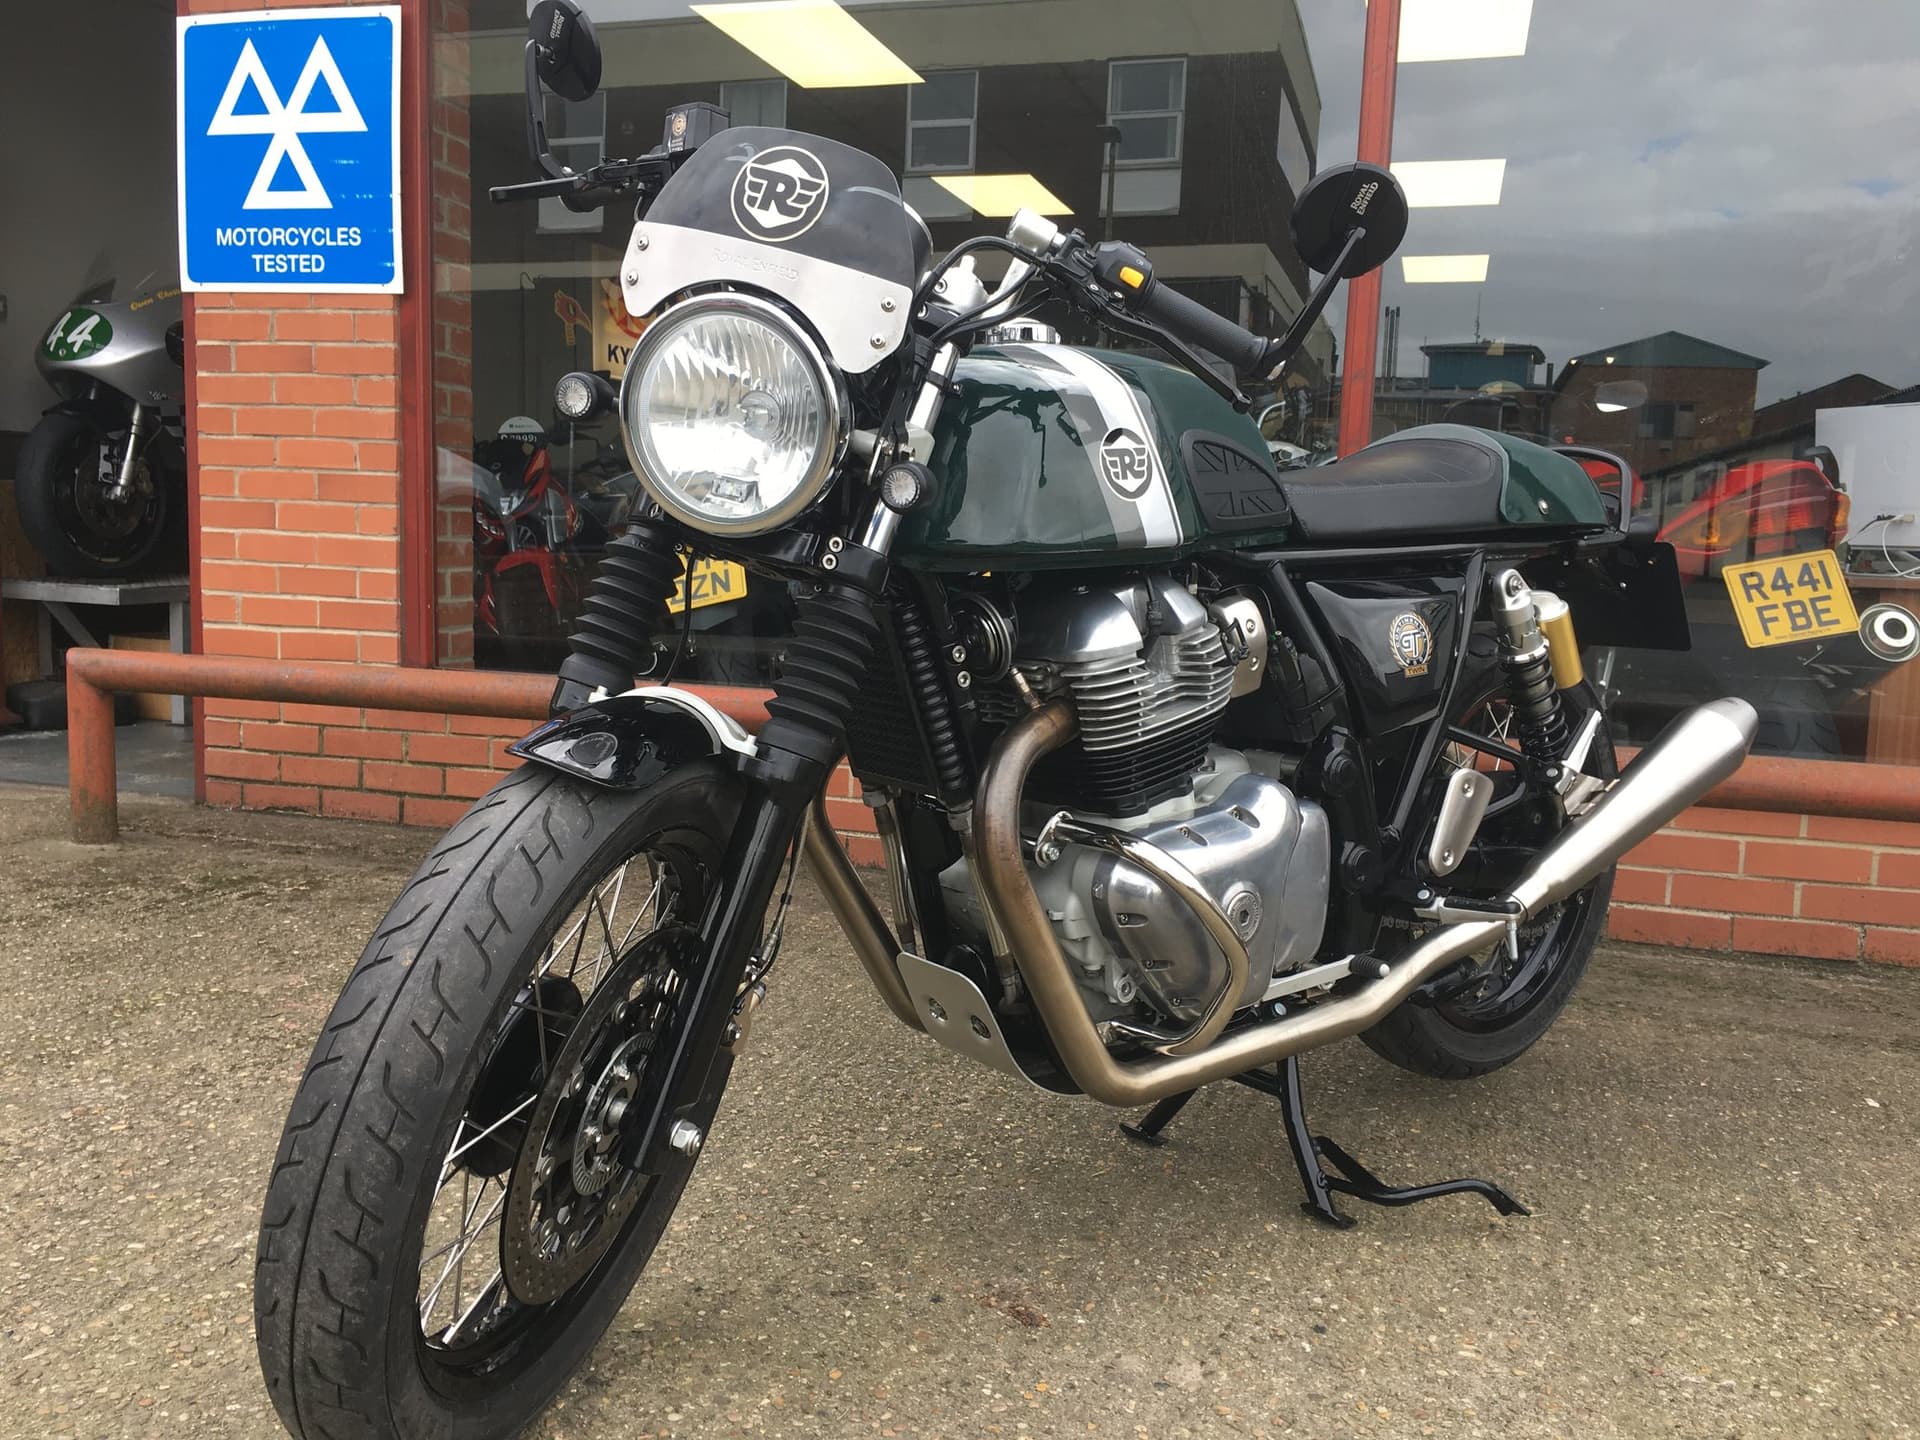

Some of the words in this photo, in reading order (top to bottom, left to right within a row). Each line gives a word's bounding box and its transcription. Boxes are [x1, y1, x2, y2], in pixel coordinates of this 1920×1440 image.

[1350, 183, 1370, 210] ROYAL
[1357, 182, 1379, 215] ENFIELD
[216, 227, 362, 246] MOTORCYCLES
[251, 254, 325, 273] TESTED
[46, 311, 101, 353] 44
[608, 344, 634, 365] KY
[1739, 561, 1832, 602] R441
[1756, 595, 1841, 637] FBE
[1400, 630, 1423, 658] GT
[1407, 666, 1425, 675] TWIN
